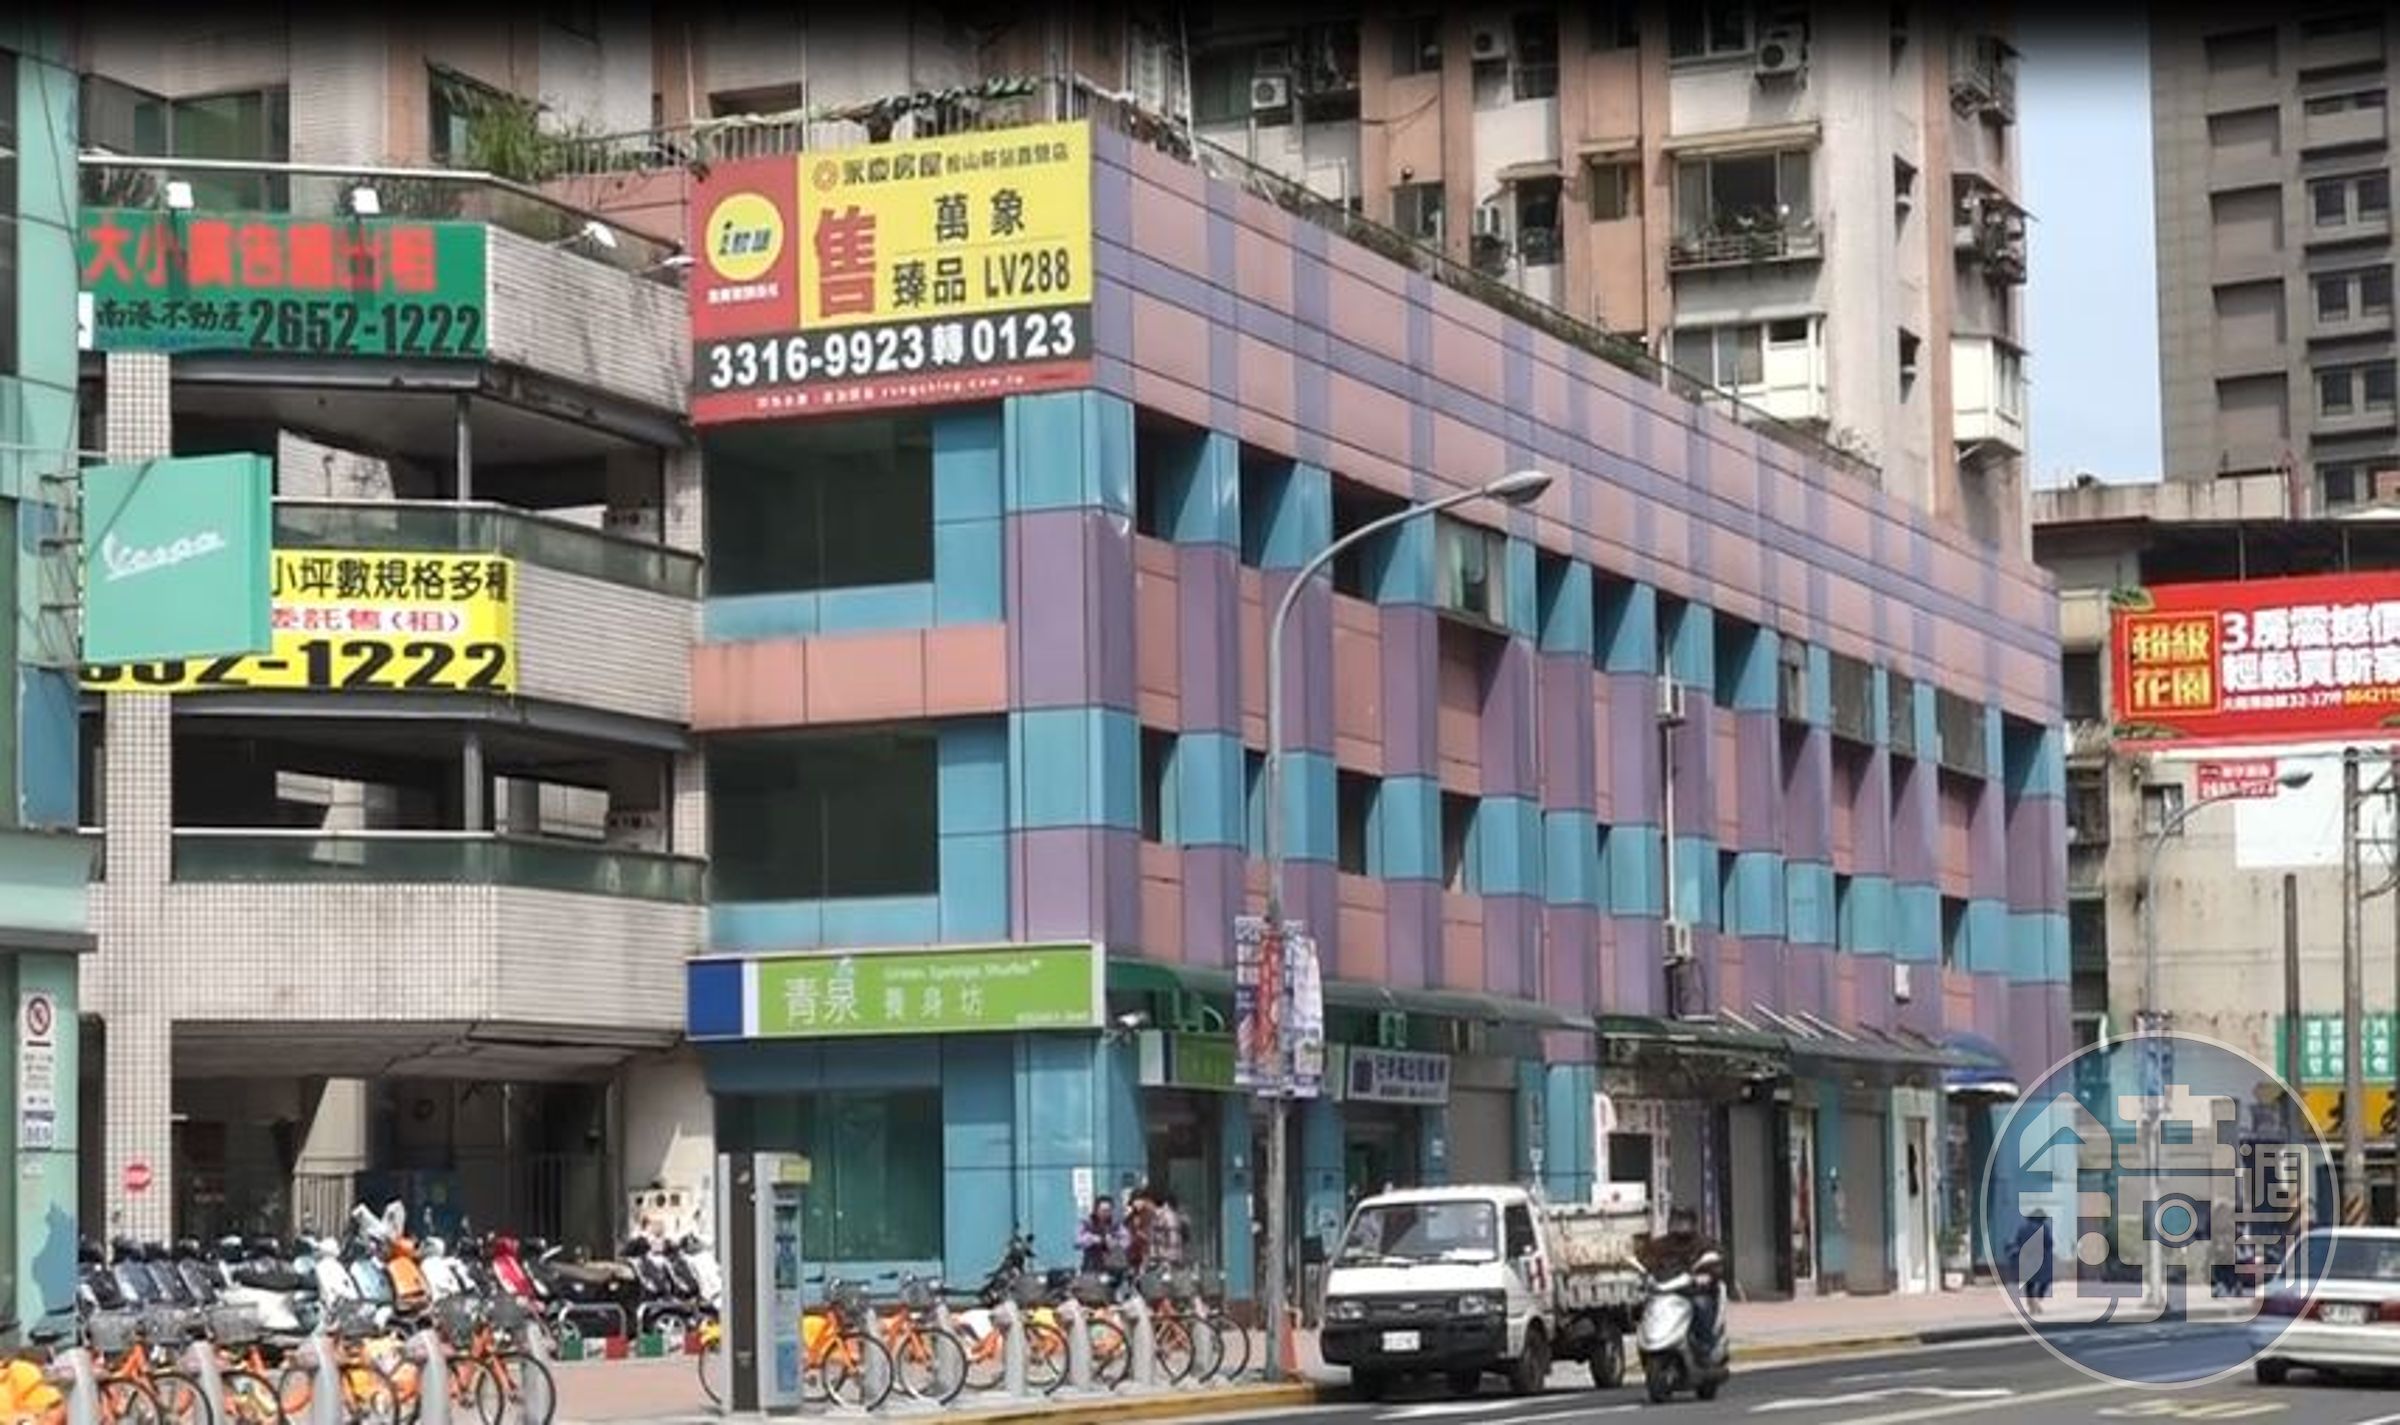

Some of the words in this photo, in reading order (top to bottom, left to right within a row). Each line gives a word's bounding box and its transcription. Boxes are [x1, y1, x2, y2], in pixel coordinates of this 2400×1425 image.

[813, 205, 877, 318] 售
[984, 249, 1071, 299] LV288
[247, 299, 484, 356] 2652-1222
[103, 530, 225, 581] Vespa
[2133, 621, 2209, 664] 超級
[2133, 667, 2210, 707] 花園
[785, 976, 859, 1027] 青泉
